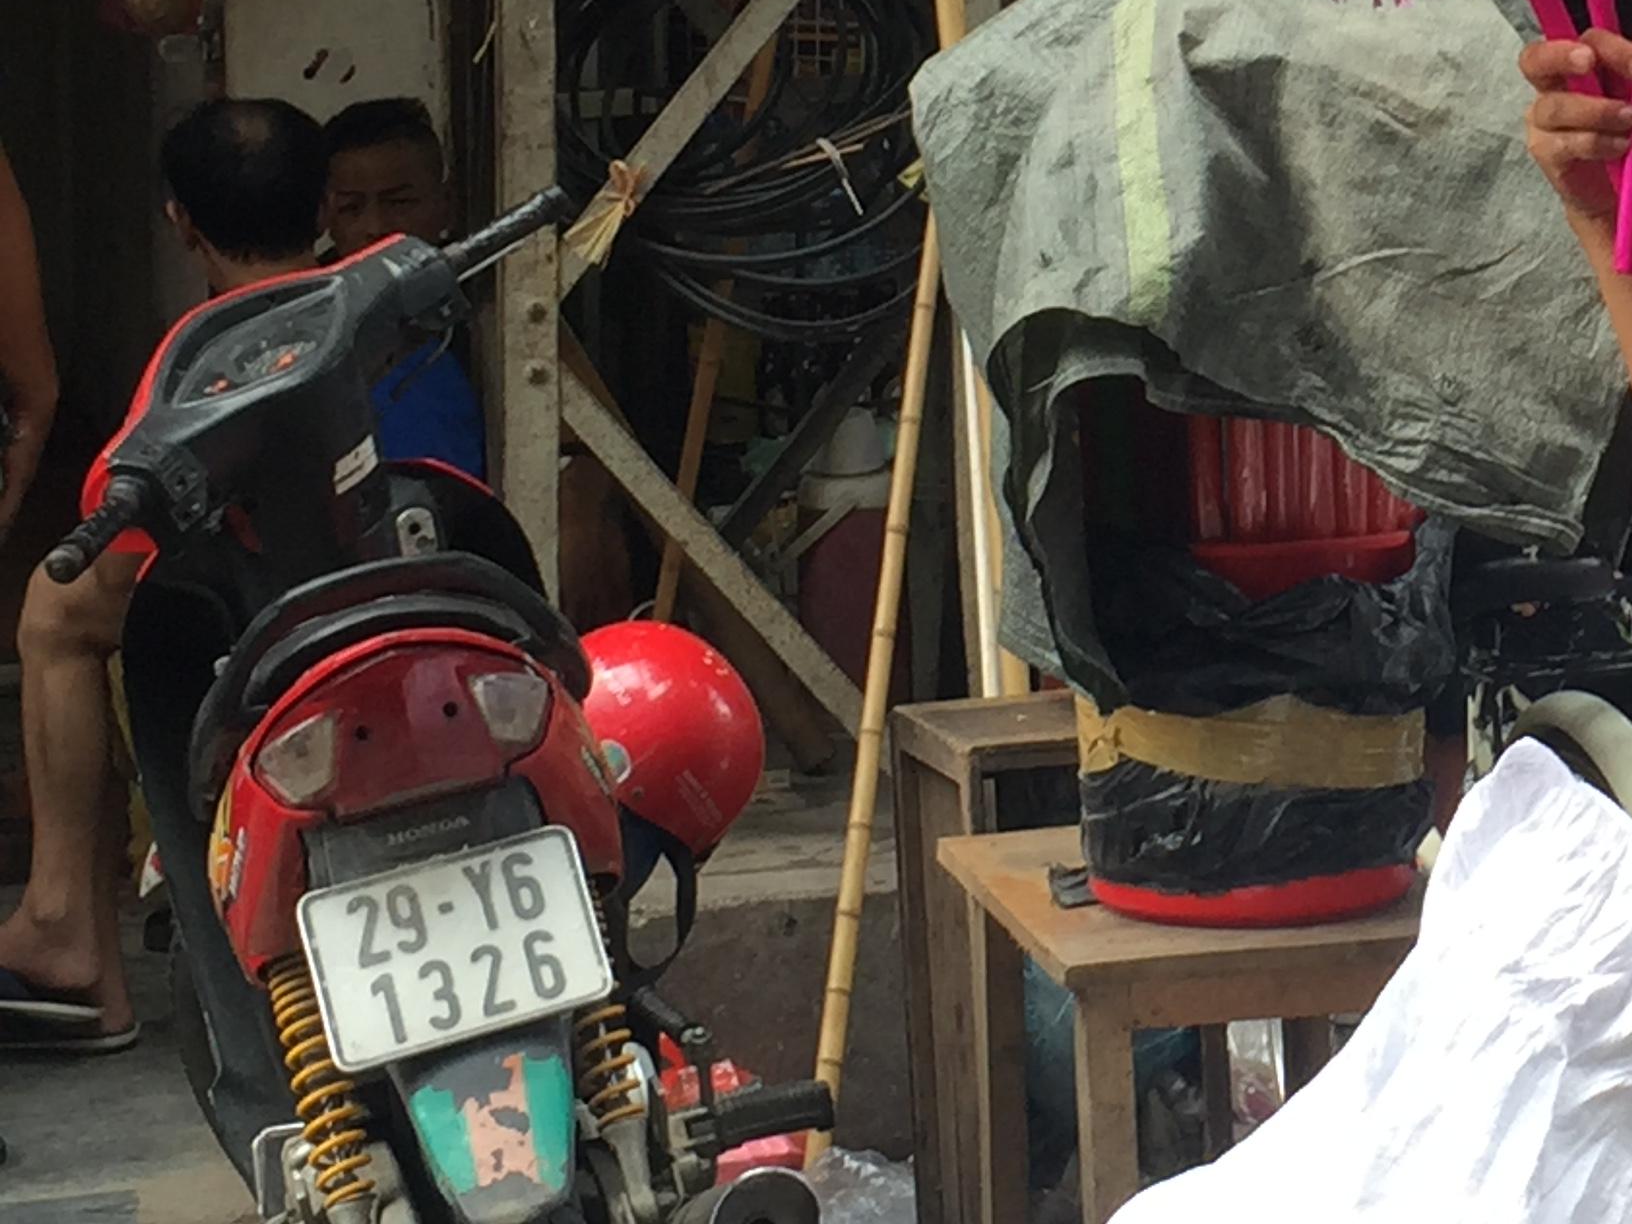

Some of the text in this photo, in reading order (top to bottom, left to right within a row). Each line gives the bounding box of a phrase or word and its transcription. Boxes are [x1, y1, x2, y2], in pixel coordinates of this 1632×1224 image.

[386, 816, 470, 846] HONDA
[346, 851, 547, 969] 29-Y6
[369, 929, 567, 1044] 1326
